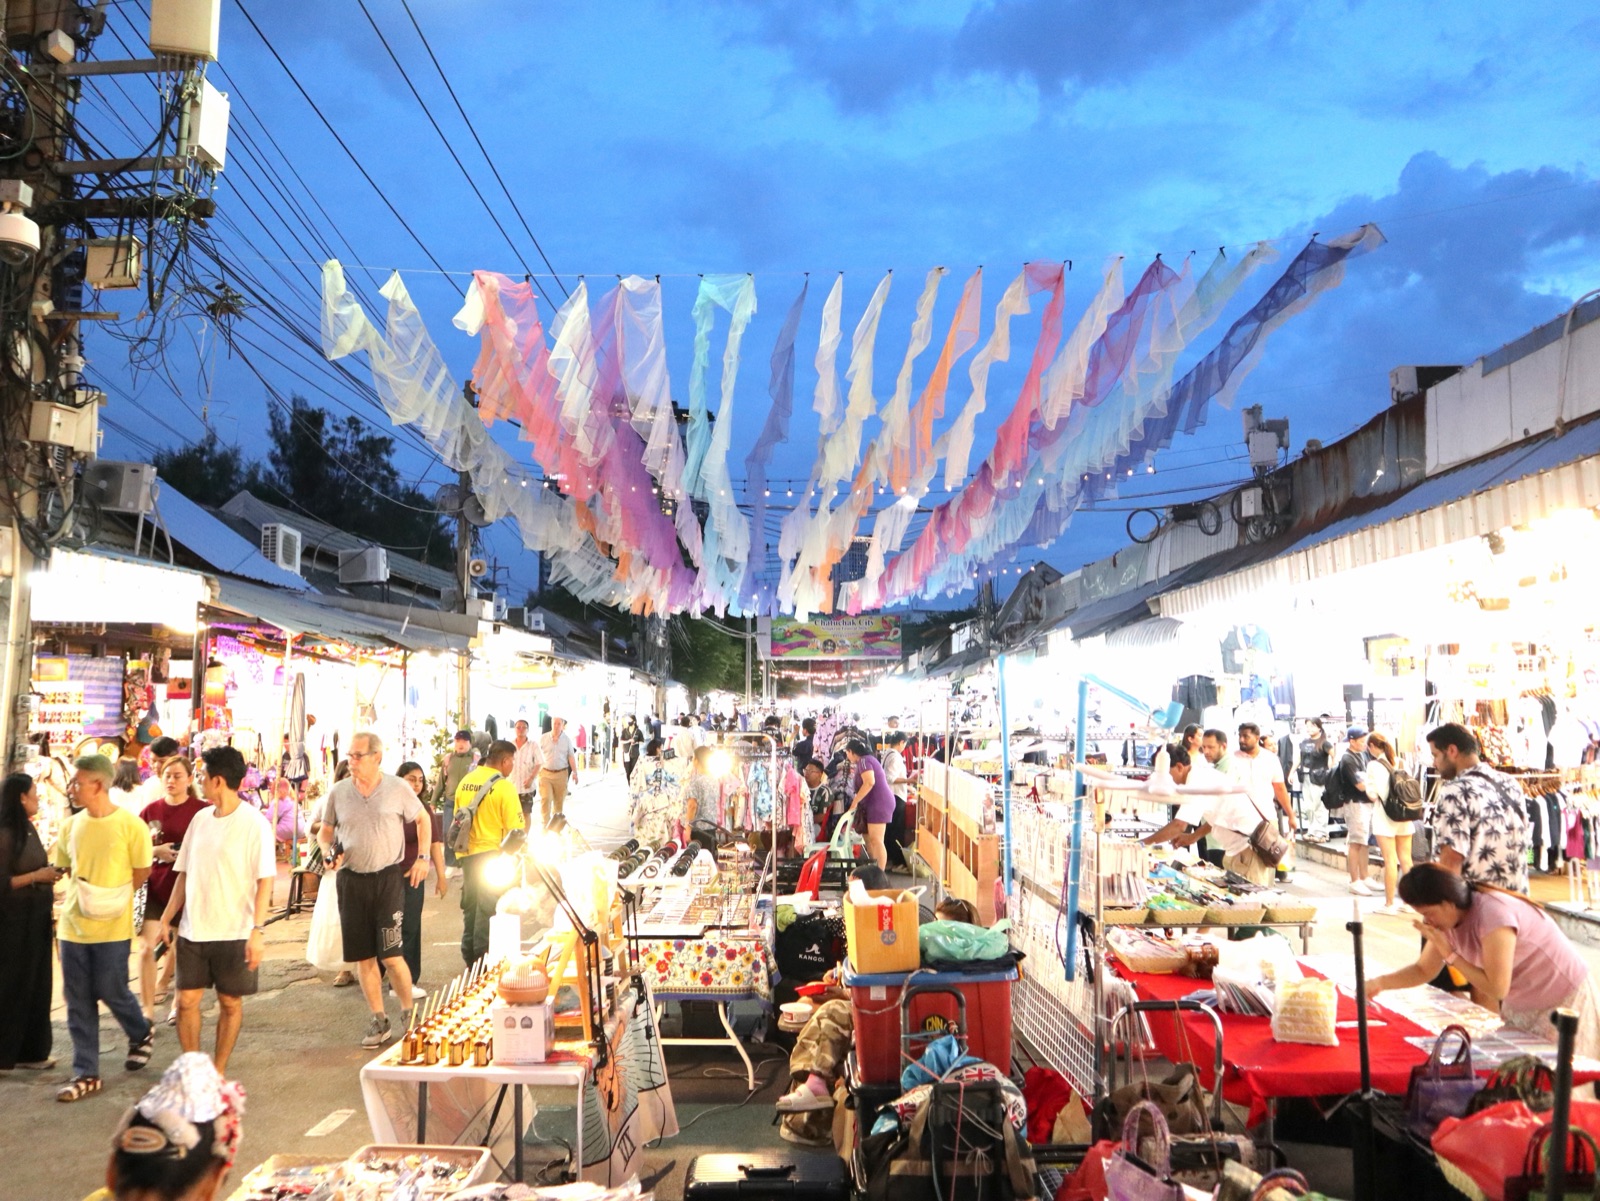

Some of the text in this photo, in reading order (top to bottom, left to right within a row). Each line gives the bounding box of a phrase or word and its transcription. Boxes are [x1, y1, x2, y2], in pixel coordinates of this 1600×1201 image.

[814, 619, 874, 628] Chatuchak City
[462, 783, 495, 795] SECUY
